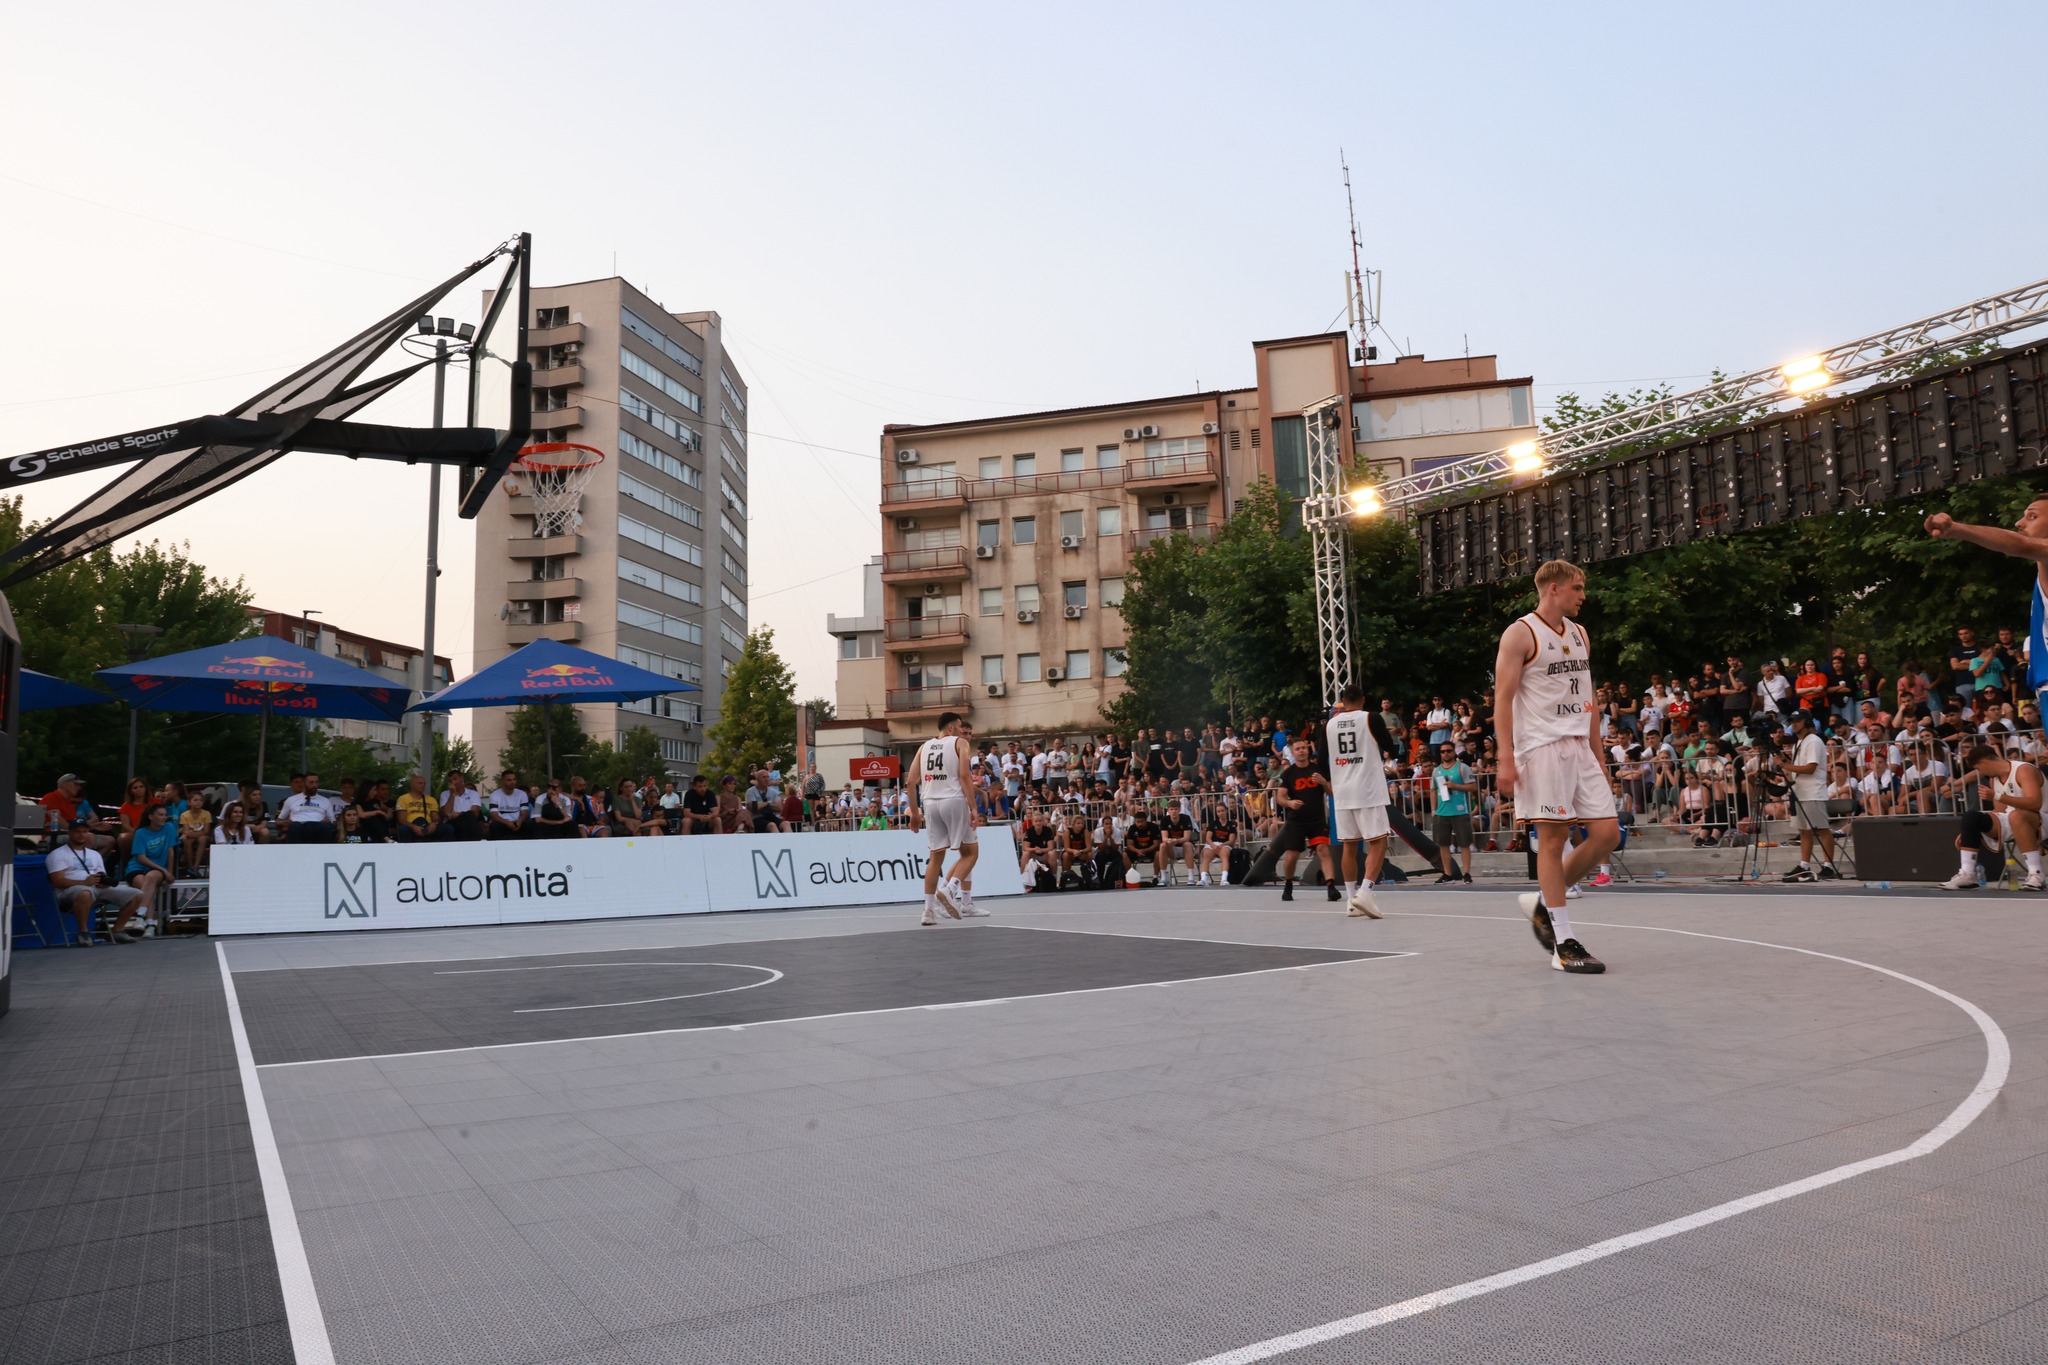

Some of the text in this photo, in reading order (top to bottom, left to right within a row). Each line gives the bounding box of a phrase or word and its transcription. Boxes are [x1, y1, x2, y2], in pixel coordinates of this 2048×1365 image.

[47, 441, 120, 463] Schelde
[123, 429, 179, 447] Sports
[207, 665, 314, 679] Red Bull
[1547, 659, 1591, 676] DEUTSCHLAN
[521, 676, 615, 688] Red Bull
[1556, 703, 1582, 715] ING
[1338, 731, 1357, 754] 63
[927, 752, 944, 771] 64
[1335, 756, 1364, 767] tipwin
[1540, 805, 1557, 815] ING
[809, 852, 943, 885] automit
